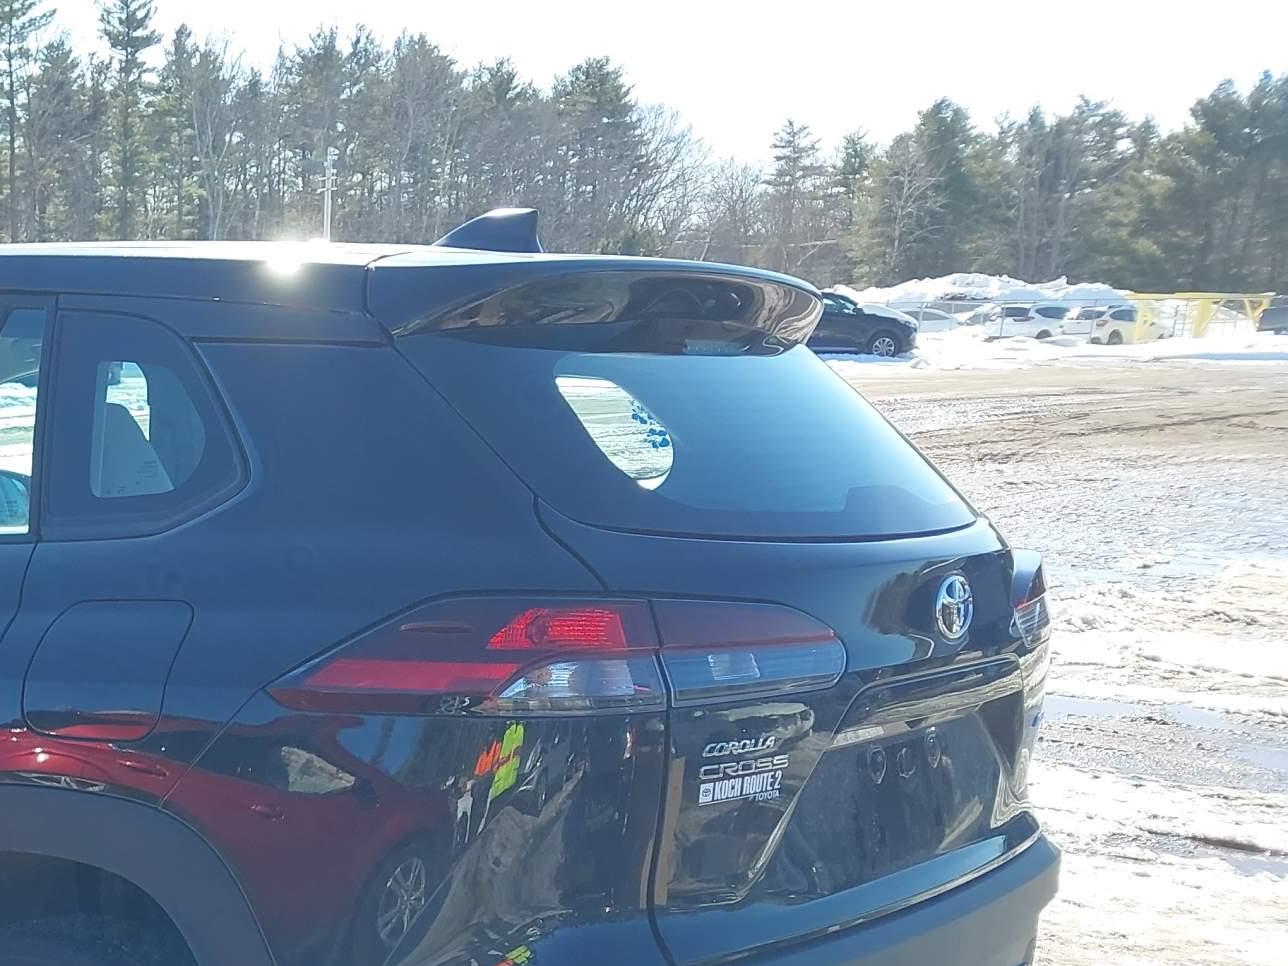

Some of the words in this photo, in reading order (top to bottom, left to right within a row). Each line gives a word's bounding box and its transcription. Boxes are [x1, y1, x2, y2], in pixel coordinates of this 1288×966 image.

[702, 736, 776, 757] COROLLA
[698, 754, 789, 780] CROSS
[713, 777, 743, 801] KOCH
[742, 771, 775, 795] ROUTE
[773, 770, 783, 789] 2
[755, 790, 780, 801] TOYOTA
